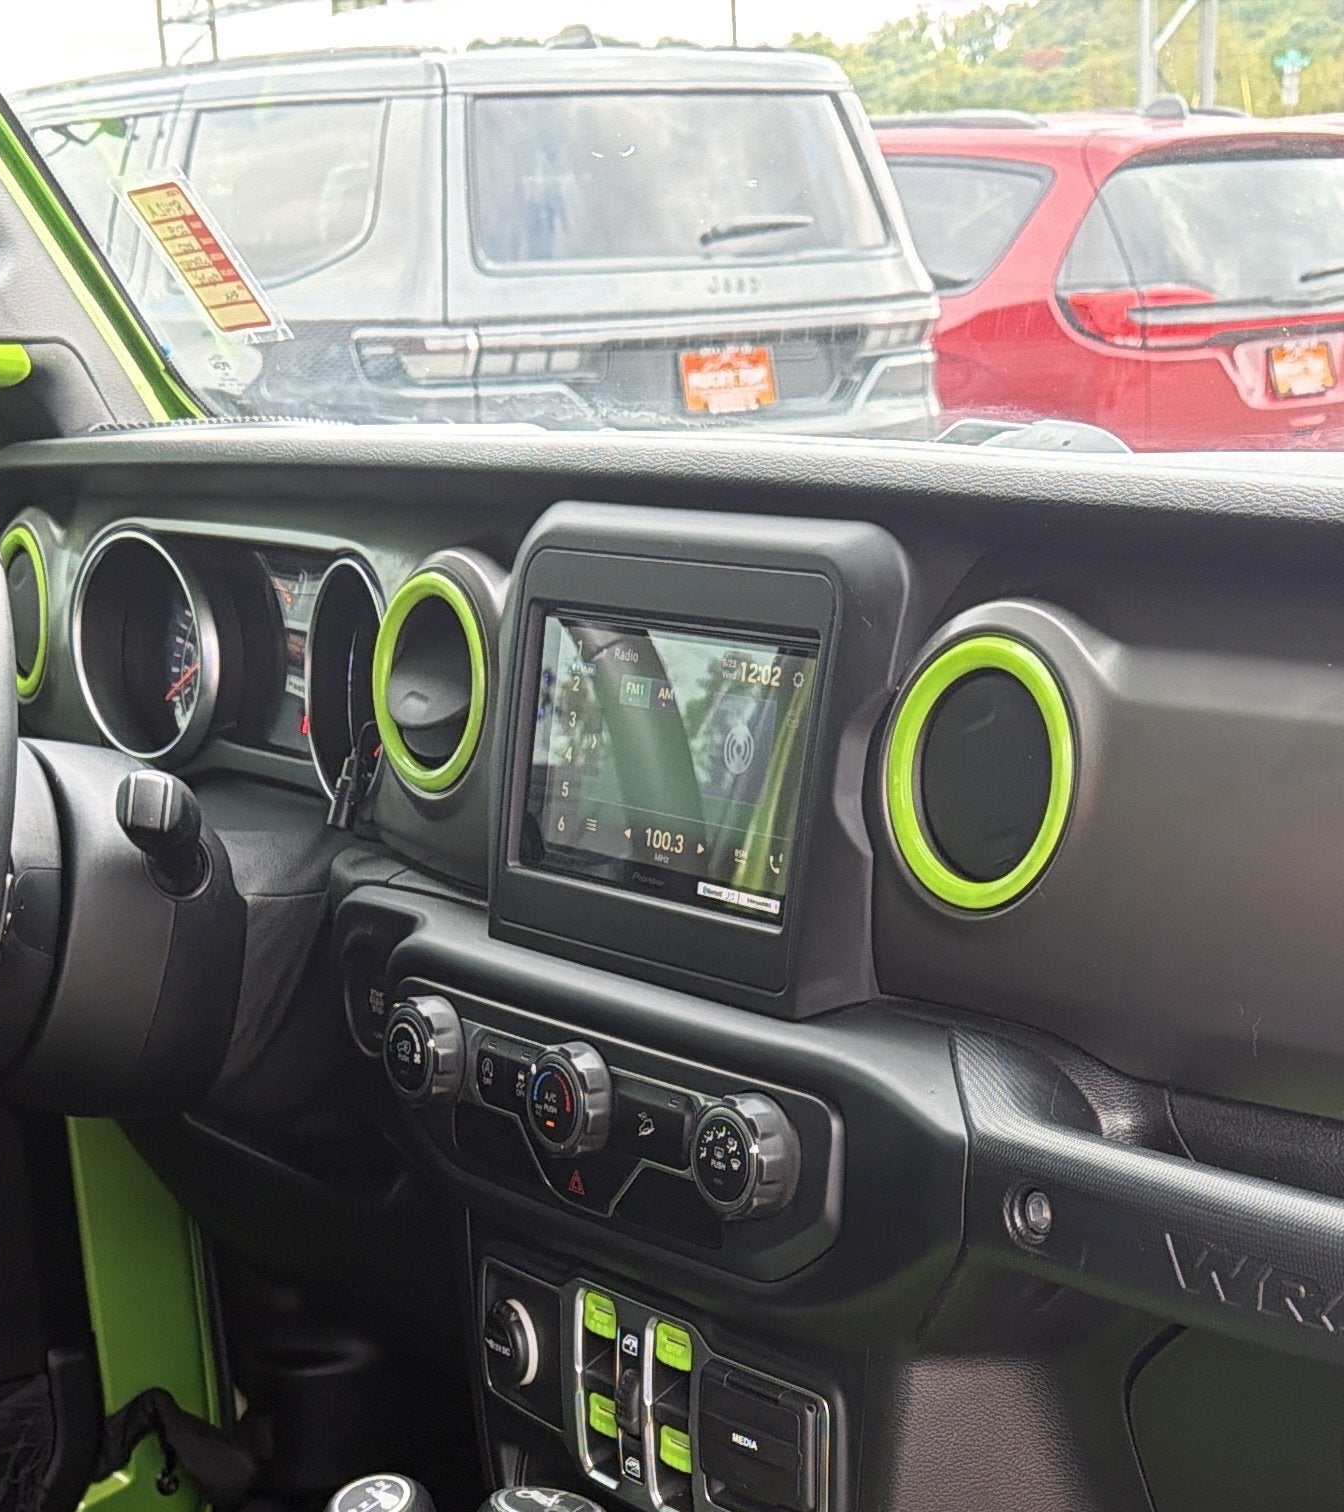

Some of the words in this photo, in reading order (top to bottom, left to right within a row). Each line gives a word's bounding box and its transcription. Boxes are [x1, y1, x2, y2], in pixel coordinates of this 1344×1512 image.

[614, 647, 639, 663] Radio
[740, 661, 782, 687] 12:02
[572, 675, 581, 692] 2
[657, 686, 675, 700] AM
[568, 710, 578, 728] 3
[564, 747, 573, 763] 4
[560, 780, 570, 798] 5
[557, 816, 566, 832] 6
[644, 827, 685, 855] 100.3
[731, 1432, 758, 1451] MEDIA
